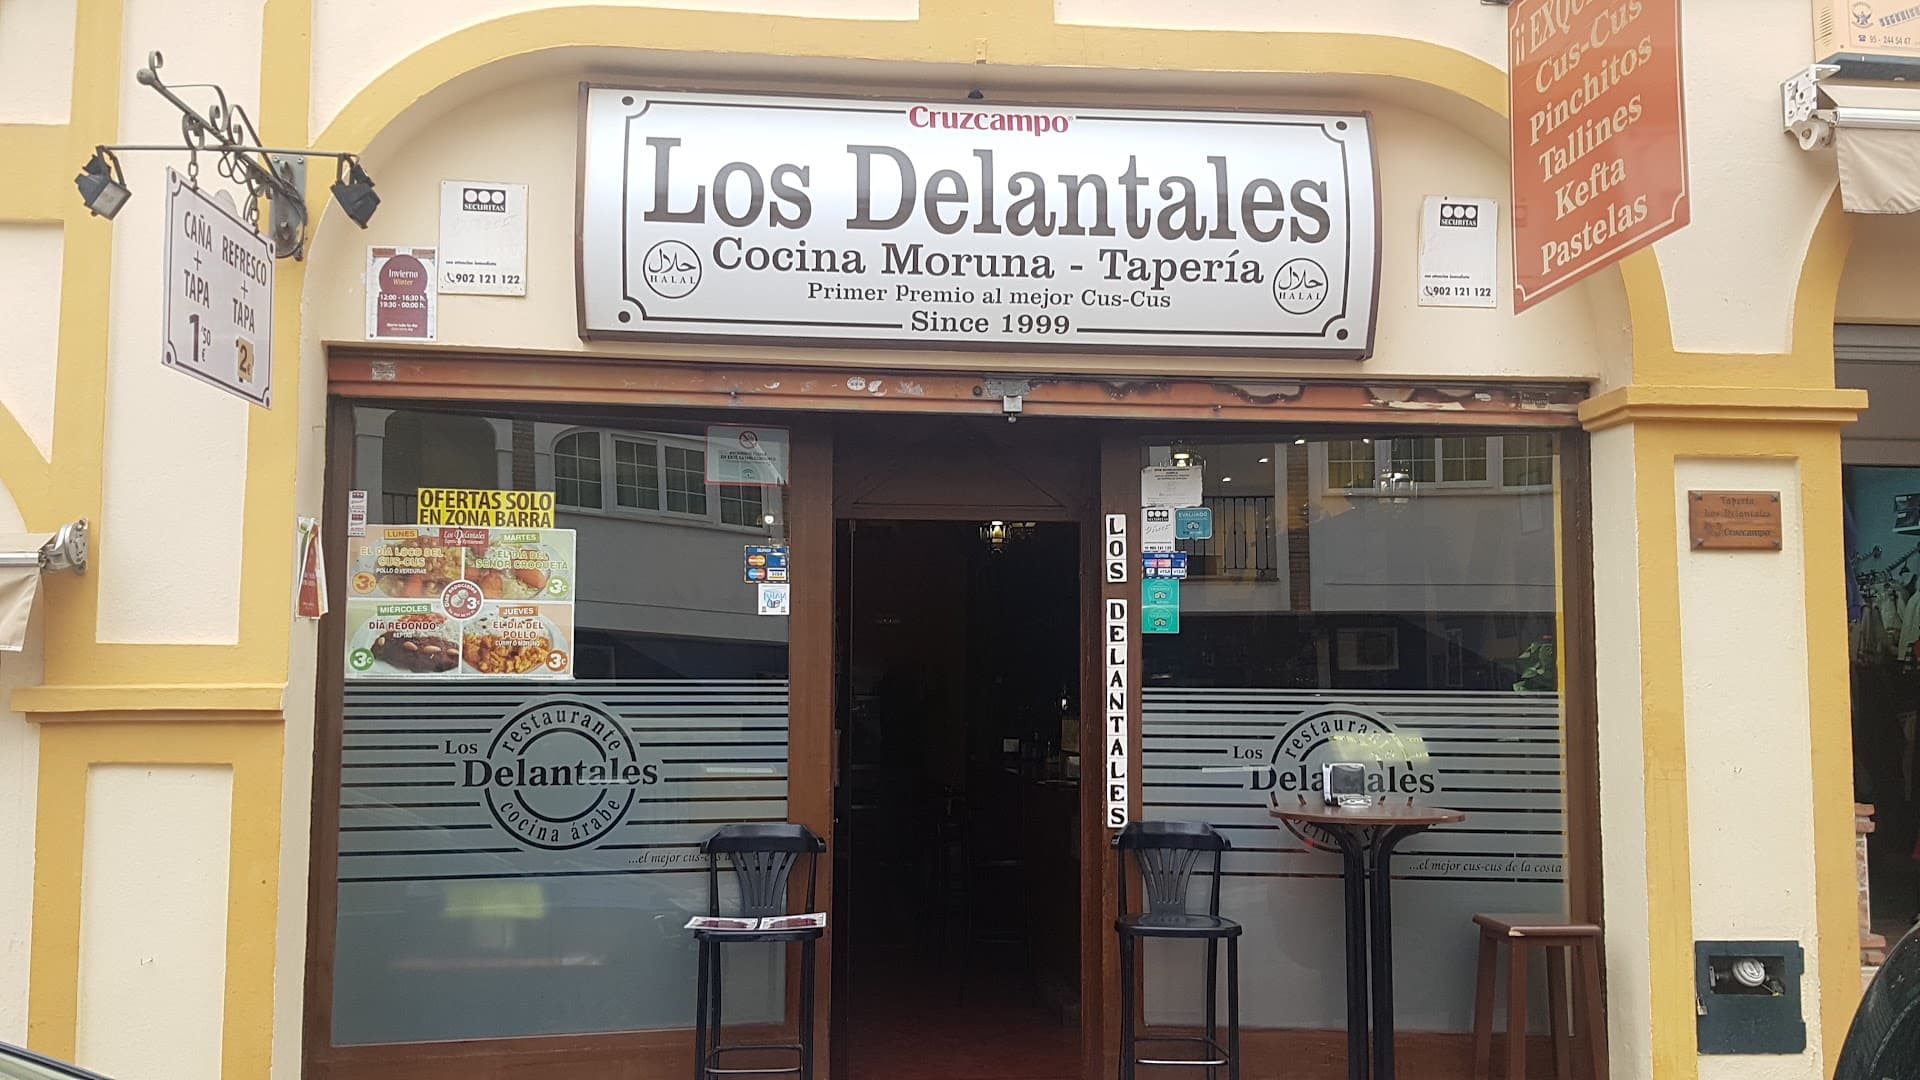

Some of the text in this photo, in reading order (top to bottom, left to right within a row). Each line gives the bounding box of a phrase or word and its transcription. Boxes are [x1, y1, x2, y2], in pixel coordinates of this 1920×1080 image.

[1535, 0, 1643, 93] Cus-Cus
[1530, 35, 1652, 146] Pinchitos
[909, 105, 1069, 136] Cruzcampo
[1539, 94, 1643, 184] Tallines
[644, 136, 1331, 244] Los Delantales
[1555, 158, 1626, 222] Kefta
[464, 202, 504, 212] SECURITAS
[184, 211, 213, 252] CAÑA
[1441, 219, 1476, 227] SECURITAS
[1540, 194, 1648, 276] Pastelas
[222, 235, 267, 286] REFRESCO
[389, 268, 418, 278] Invierno
[713, 237, 866, 274] Cocina
[881, 243, 1055, 279] Moruna
[1099, 249, 1265, 291] Tapería
[184, 269, 210, 308] TAPA
[393, 278, 413, 286] Winter
[456, 273, 520, 284] 902 121 122
[650, 275, 695, 284] HALAL
[807, 282, 1170, 309] Primer Premio al mejor Cus-Cus
[1279, 291, 1322, 300] HALAL
[1433, 287, 1491, 297] 902 121 122
[232, 298, 255, 334] TAPA
[911, 310, 1070, 335] Since 1999
[420, 489, 552, 511] OFERTAS SOLO
[420, 509, 551, 528] EN ZONA BARRA
[387, 530, 415, 538] LUNES
[503, 533, 536, 541] MARTES
[1109, 518, 1124, 580] LOS
[503, 607, 534, 615] JUEVES
[388, 621, 437, 630] REDONDO
[503, 630, 537, 639] POLLO
[1109, 602, 1125, 826] DELANTALES
[502, 709, 621, 754] restaurante
[445, 740, 478, 754] Los
[1233, 746, 1263, 760] Los
[462, 757, 658, 787] Delantales
[1250, 764, 1435, 794] Delaales
[500, 799, 621, 843] cocina árabe
[651, 851, 682, 867] mejor
[1431, 859, 1461, 875] mejor
[1463, 861, 1502, 872] cus-cus
[1505, 860, 1518, 872] de
[1520, 860, 1531, 872] la
[1534, 862, 1562, 873] costa
